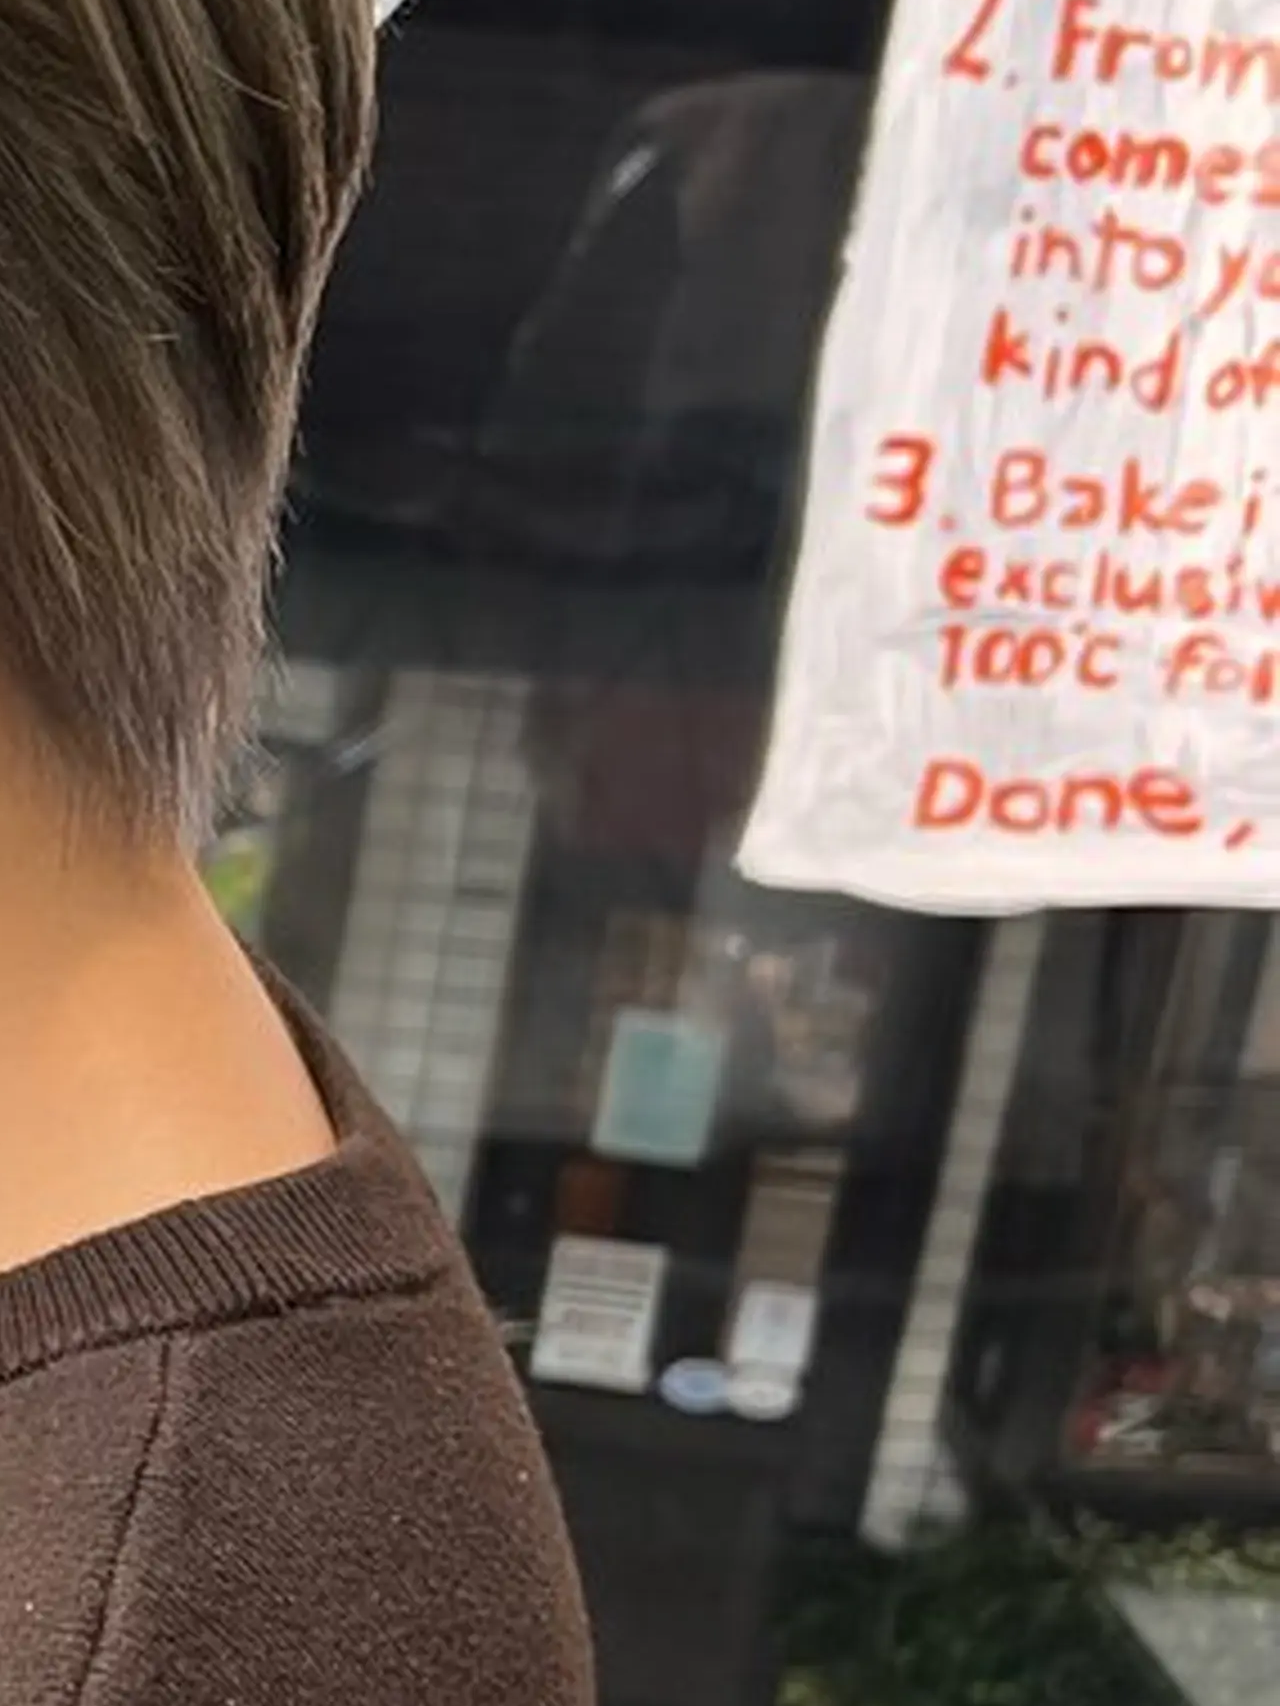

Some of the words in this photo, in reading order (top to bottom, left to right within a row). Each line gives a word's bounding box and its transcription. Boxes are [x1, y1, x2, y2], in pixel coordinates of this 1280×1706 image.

[1009, 207, 1189, 291] into
[979, 307, 1184, 413] kind
[866, 431, 959, 533] 3.
[987, 445, 1222, 537] Bake
[905, 754, 1259, 853] Done,
